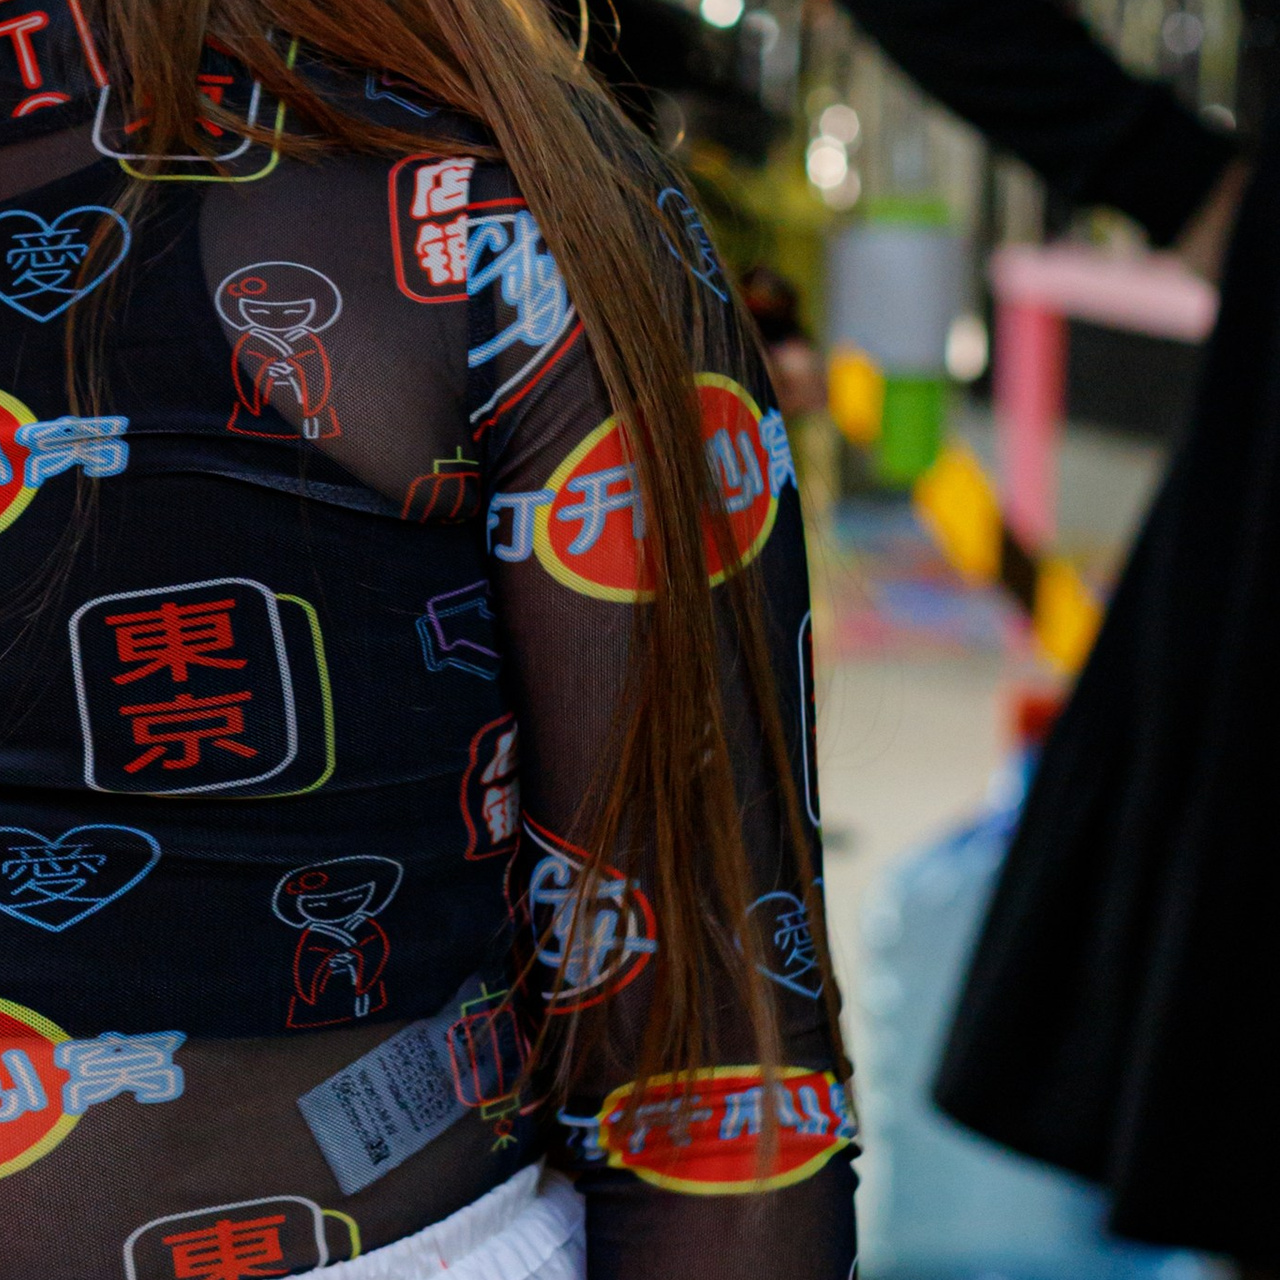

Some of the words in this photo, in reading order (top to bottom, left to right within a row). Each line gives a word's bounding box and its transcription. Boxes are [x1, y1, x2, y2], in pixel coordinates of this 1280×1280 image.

[7, 228, 90, 301] 愛
[104, 597, 259, 775] 東京
[1, 843, 108, 909] 愛
